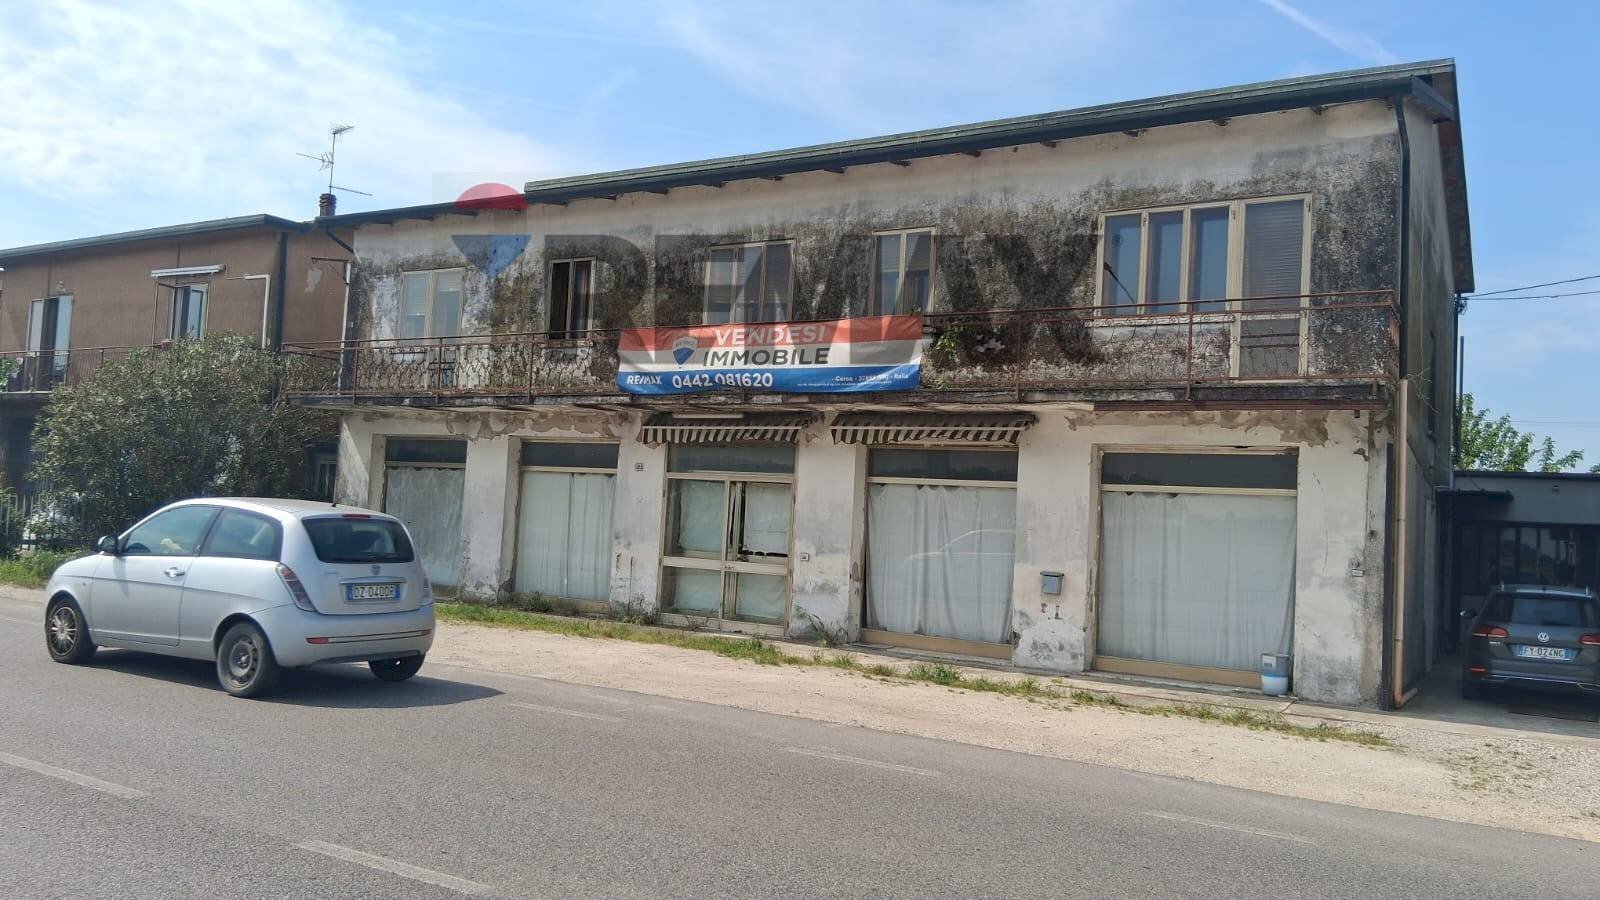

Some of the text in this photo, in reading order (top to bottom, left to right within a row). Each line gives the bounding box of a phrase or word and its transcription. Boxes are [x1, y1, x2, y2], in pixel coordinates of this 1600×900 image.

[715, 325, 826, 346] VENDESI
[703, 347, 830, 366] IMMOBILE
[626, 375, 662, 385] RE/MAX
[672, 372, 773, 388] 0442 081620
